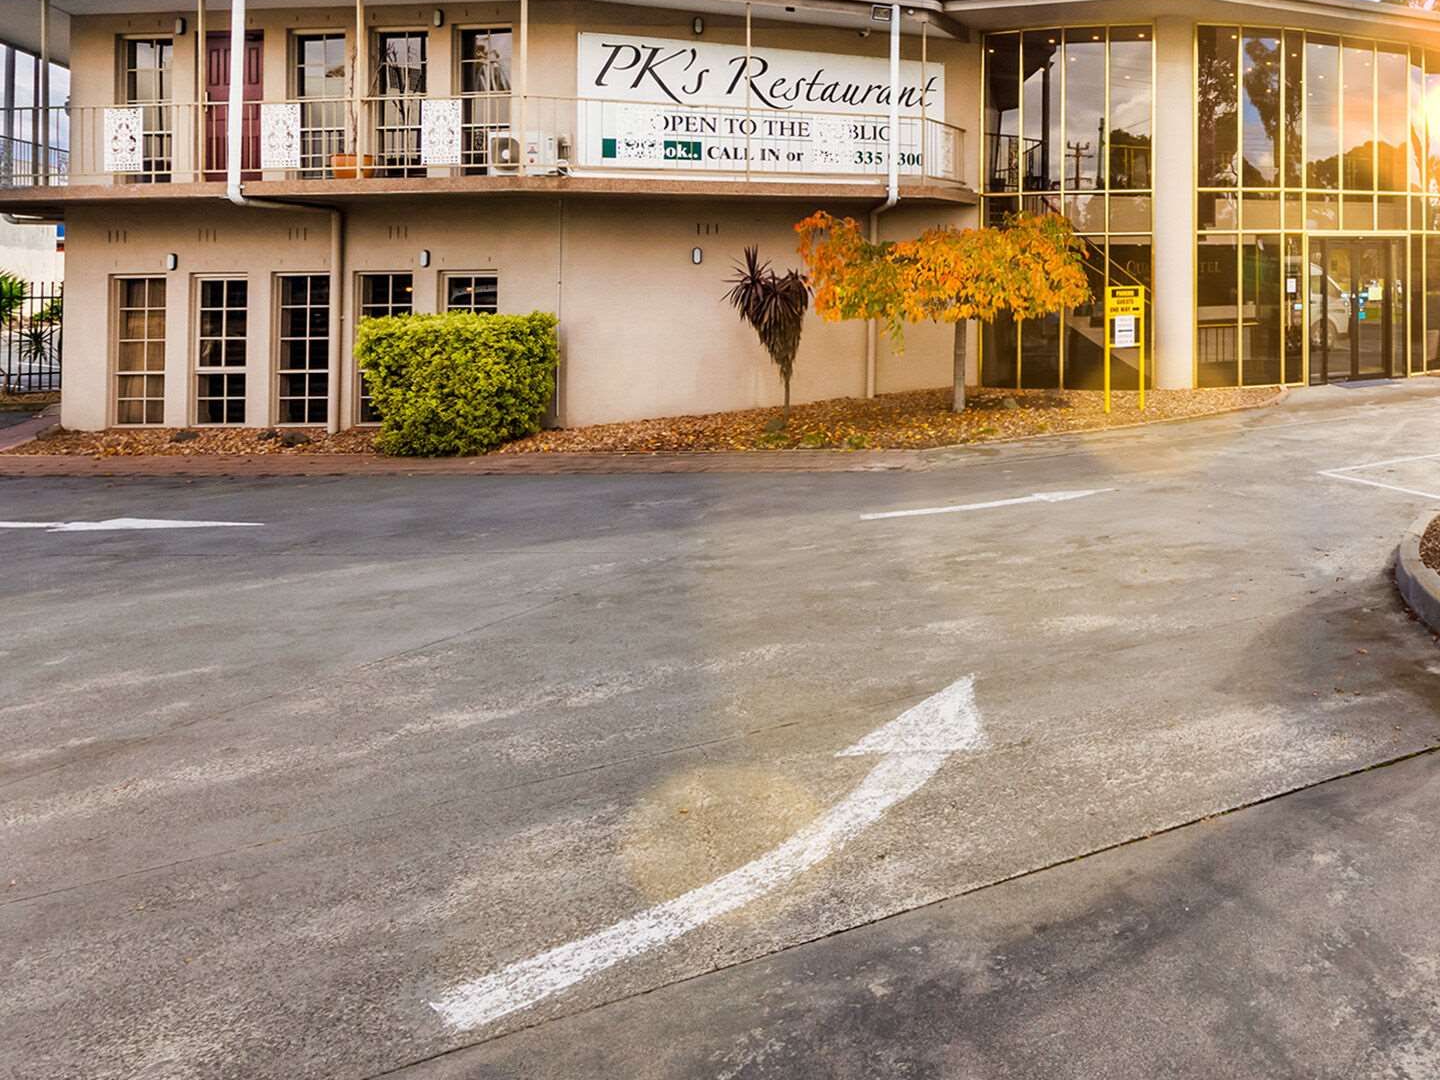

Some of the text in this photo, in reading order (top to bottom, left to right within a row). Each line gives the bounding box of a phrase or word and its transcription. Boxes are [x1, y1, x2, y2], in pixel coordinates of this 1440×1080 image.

[594, 42, 939, 110] PK's Restaurant
[724, 117, 757, 136] TO
[764, 119, 810, 138] THE
[706, 145, 754, 161] CALL
[760, 148, 780, 161] IN
[786, 151, 804, 162] or
[851, 150, 883, 165] 335
